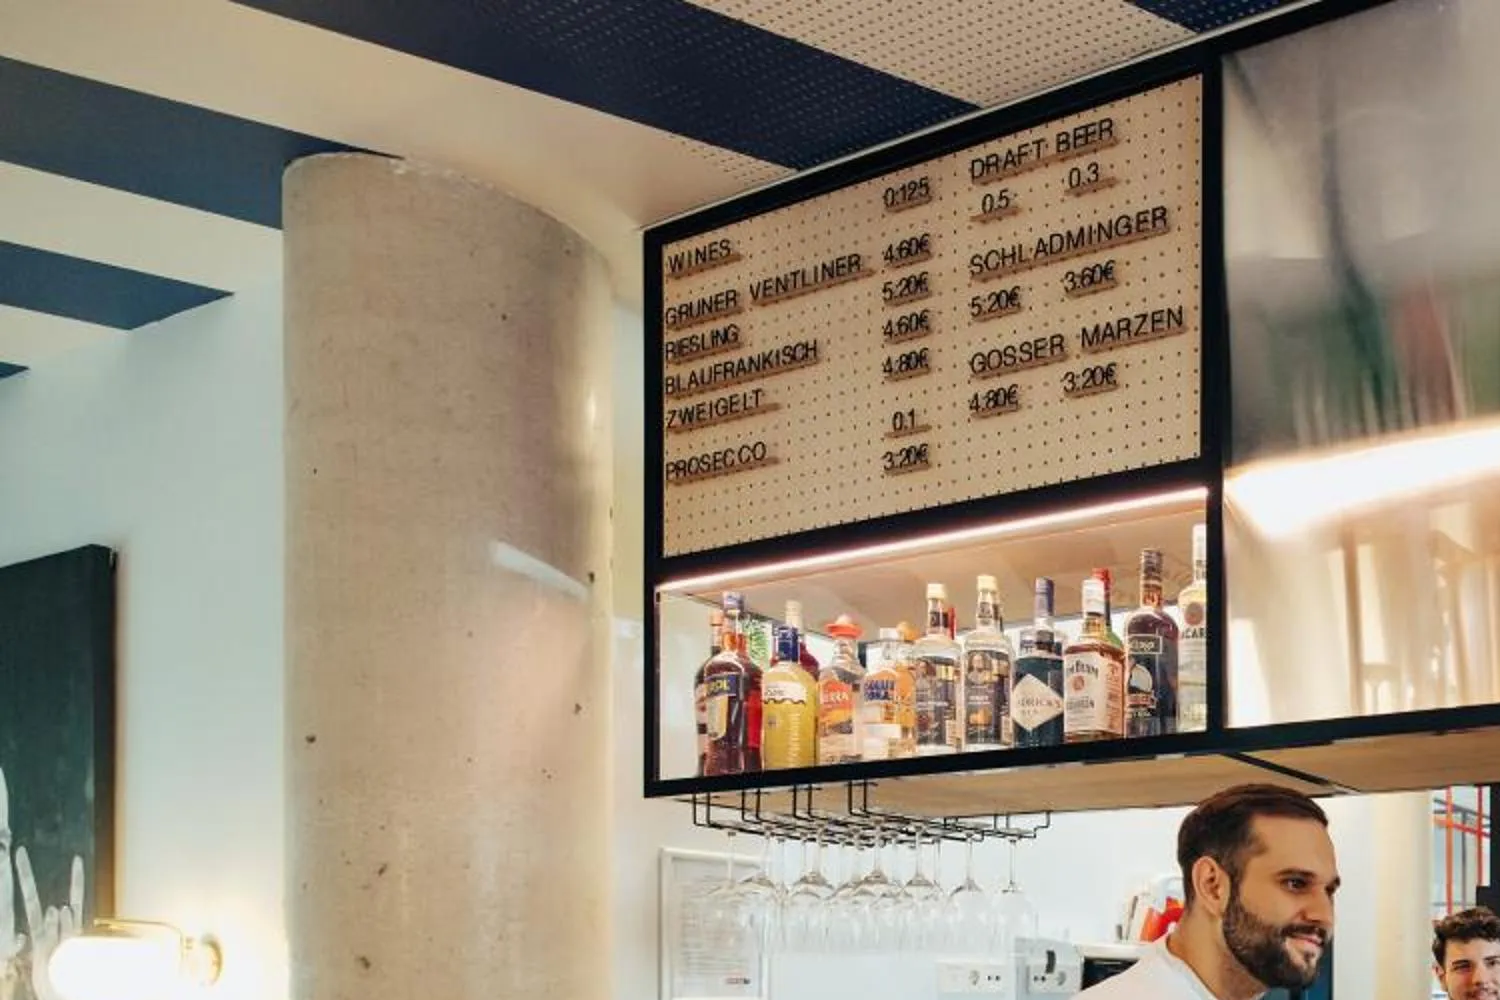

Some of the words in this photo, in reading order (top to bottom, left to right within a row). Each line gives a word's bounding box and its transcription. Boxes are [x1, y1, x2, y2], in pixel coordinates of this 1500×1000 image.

[970, 138, 1046, 180] DRAFT
[1056, 117, 1115, 153] BEER
[1068, 162, 1100, 189] 0.3
[668, 239, 732, 273] WINES
[969, 205, 1168, 275] SCHLADMINGER
[665, 289, 738, 326] GRUNER
[750, 253, 862, 300] VENTLINER
[665, 323, 740, 360] RIESLING
[969, 334, 1065, 374] GOSSER
[1080, 305, 1184, 348] MARZEN
[665, 339, 818, 395] BLAUFRANKISCH
[667, 388, 763, 428] ZWEIGELT
[891, 407, 916, 432] 0.1
[666, 440, 767, 480] PROSECCO
